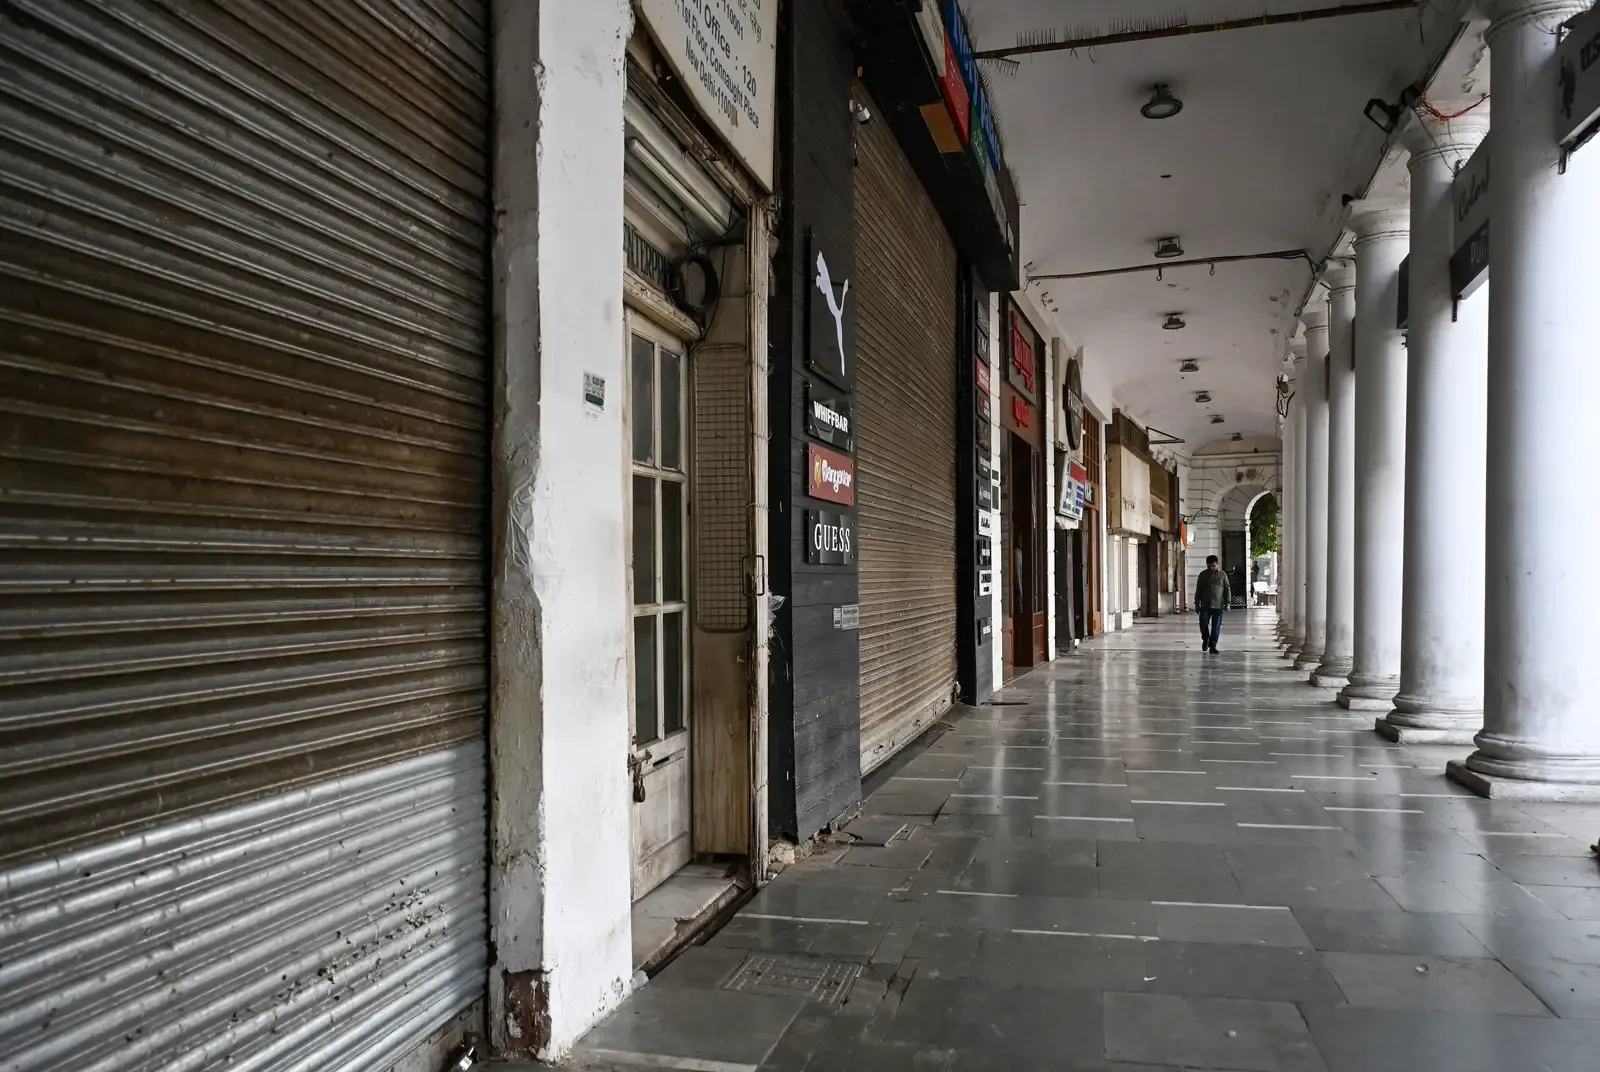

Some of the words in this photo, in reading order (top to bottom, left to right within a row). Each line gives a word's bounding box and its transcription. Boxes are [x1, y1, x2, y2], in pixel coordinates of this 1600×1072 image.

[685, 36, 699, 73] New
[704, 4, 731, 59] Office
[742, 65, 757, 97] 120
[710, 47, 743, 108] Connaught
[744, 95, 760, 129] Place
[814, 522, 850, 553] GUESS
